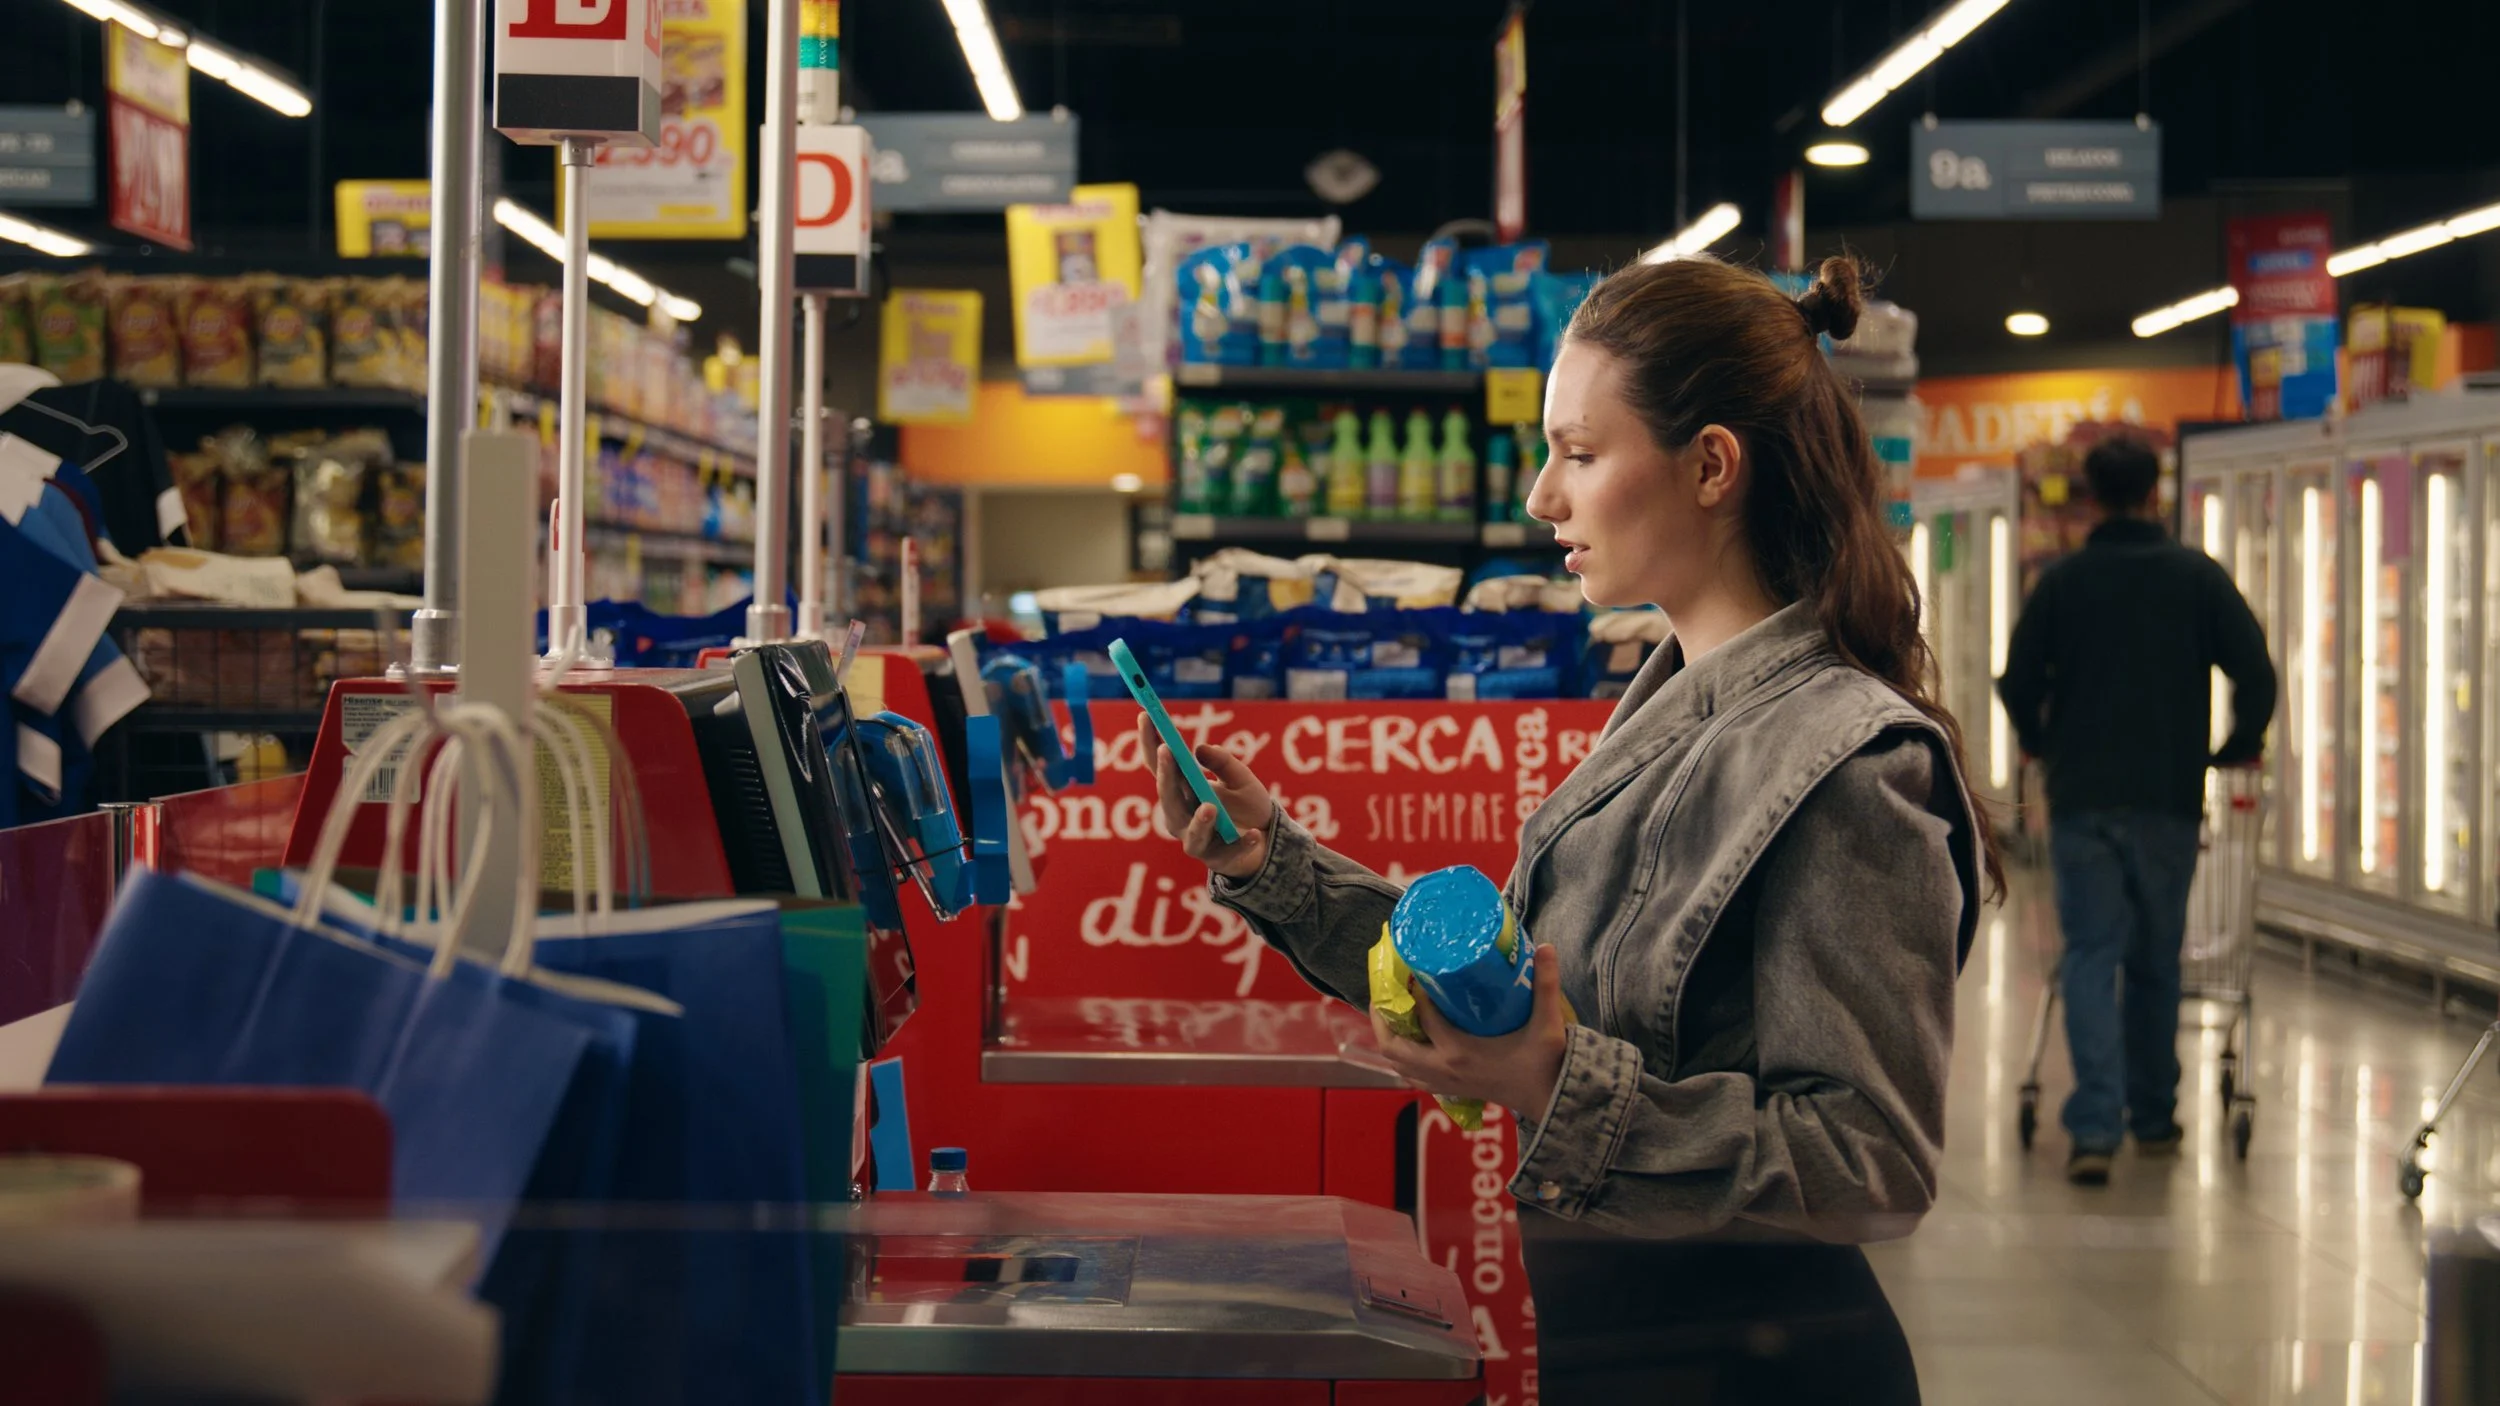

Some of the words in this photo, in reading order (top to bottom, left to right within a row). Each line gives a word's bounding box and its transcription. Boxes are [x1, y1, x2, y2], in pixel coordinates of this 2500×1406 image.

[795, 153, 852, 228] D
[1929, 150, 1991, 190] 9a
[343, 696, 384, 706] Hisense
[1282, 714, 1504, 774] CERCA
[1366, 791, 1506, 843] SIEMPRE
